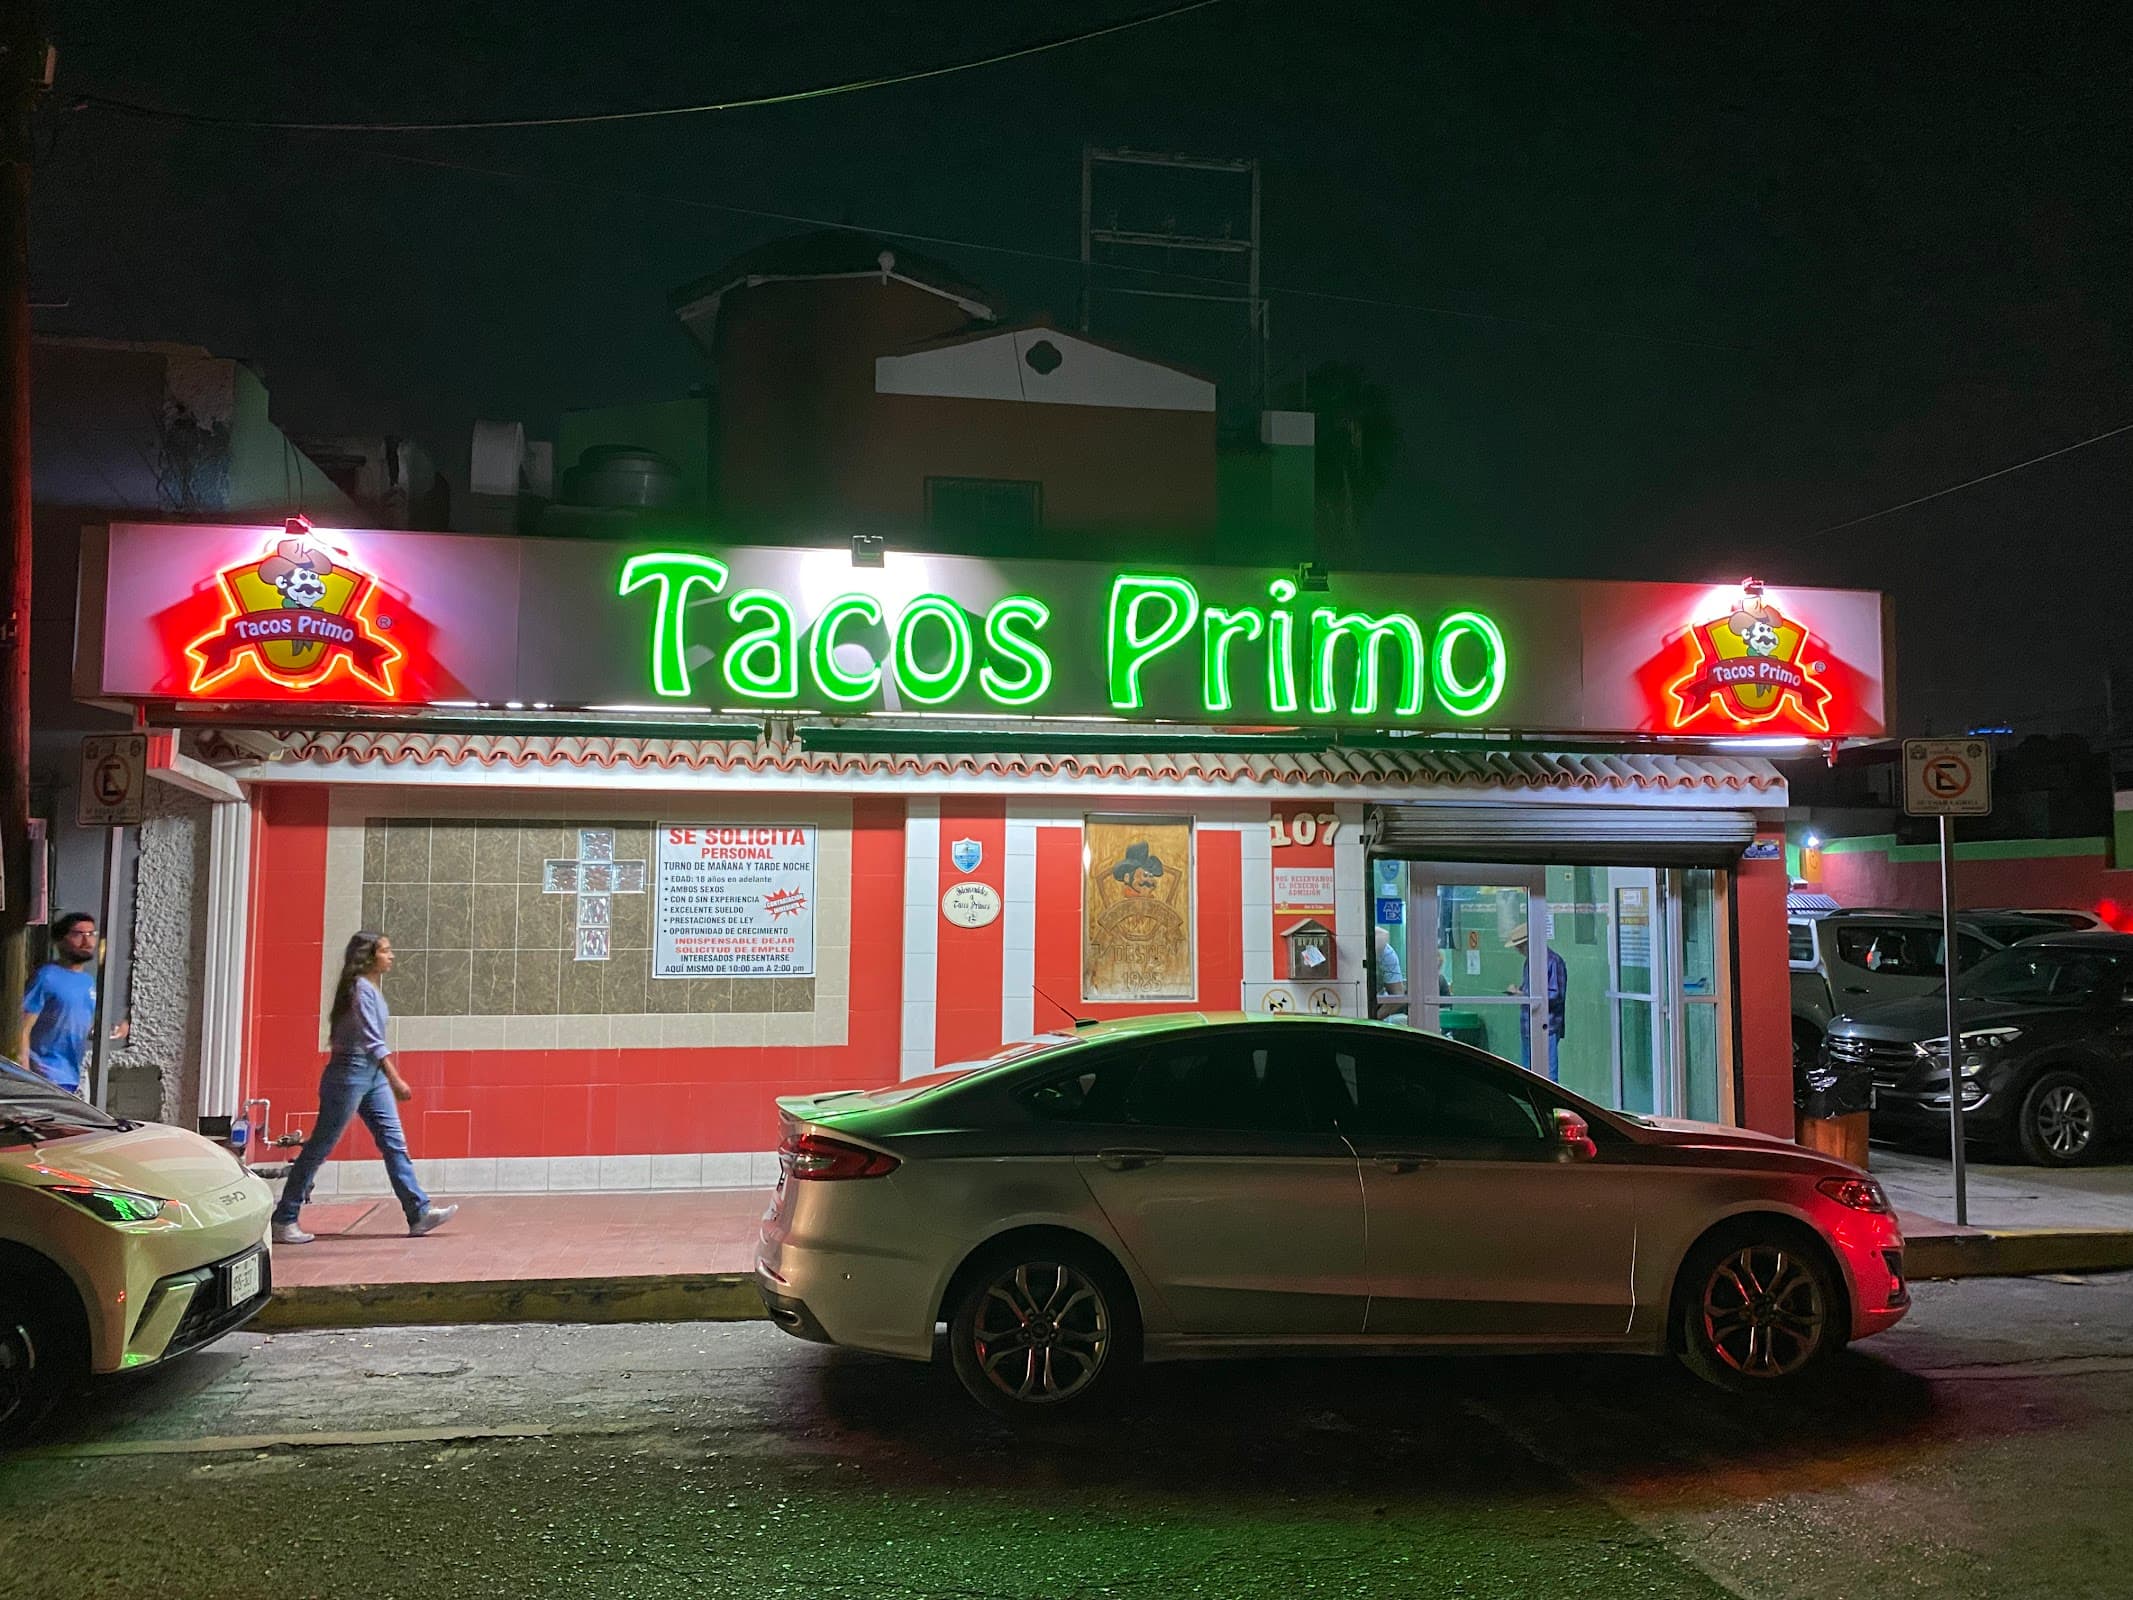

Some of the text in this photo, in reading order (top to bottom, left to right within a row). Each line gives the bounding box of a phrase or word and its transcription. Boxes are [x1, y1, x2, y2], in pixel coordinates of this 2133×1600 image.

[234, 615, 354, 643] Tacos Primo
[617, 550, 1510, 718] Tacos Primo
[1712, 662, 1802, 687] Tacos Primo
[1267, 812, 1341, 847] 107
[669, 827, 806, 846] SE SOLICITA
[701, 847, 773, 860] PERSONAL
[664, 860, 810, 871] TURNO DE MAÑANA Y TARDE NOCHE
[670, 875, 693, 883] EDAD:
[696, 875, 705, 883] 18
[707, 875, 725, 883] años
[738, 875, 772, 883] adelante
[669, 927, 789, 935] OPORTUNIDAD DE CRECIMIENTO
[680, 954, 790, 962] INTERESADOS PRESENTARSE
[665, 963, 685, 973] AQUÍ
[686, 964, 714, 973] MISMO
[716, 964, 727, 973] DE
[729, 964, 750, 972] 10:00
[765, 964, 772, 972] A
[773, 964, 791, 972] 2:00
[792, 966, 804, 974] pm
